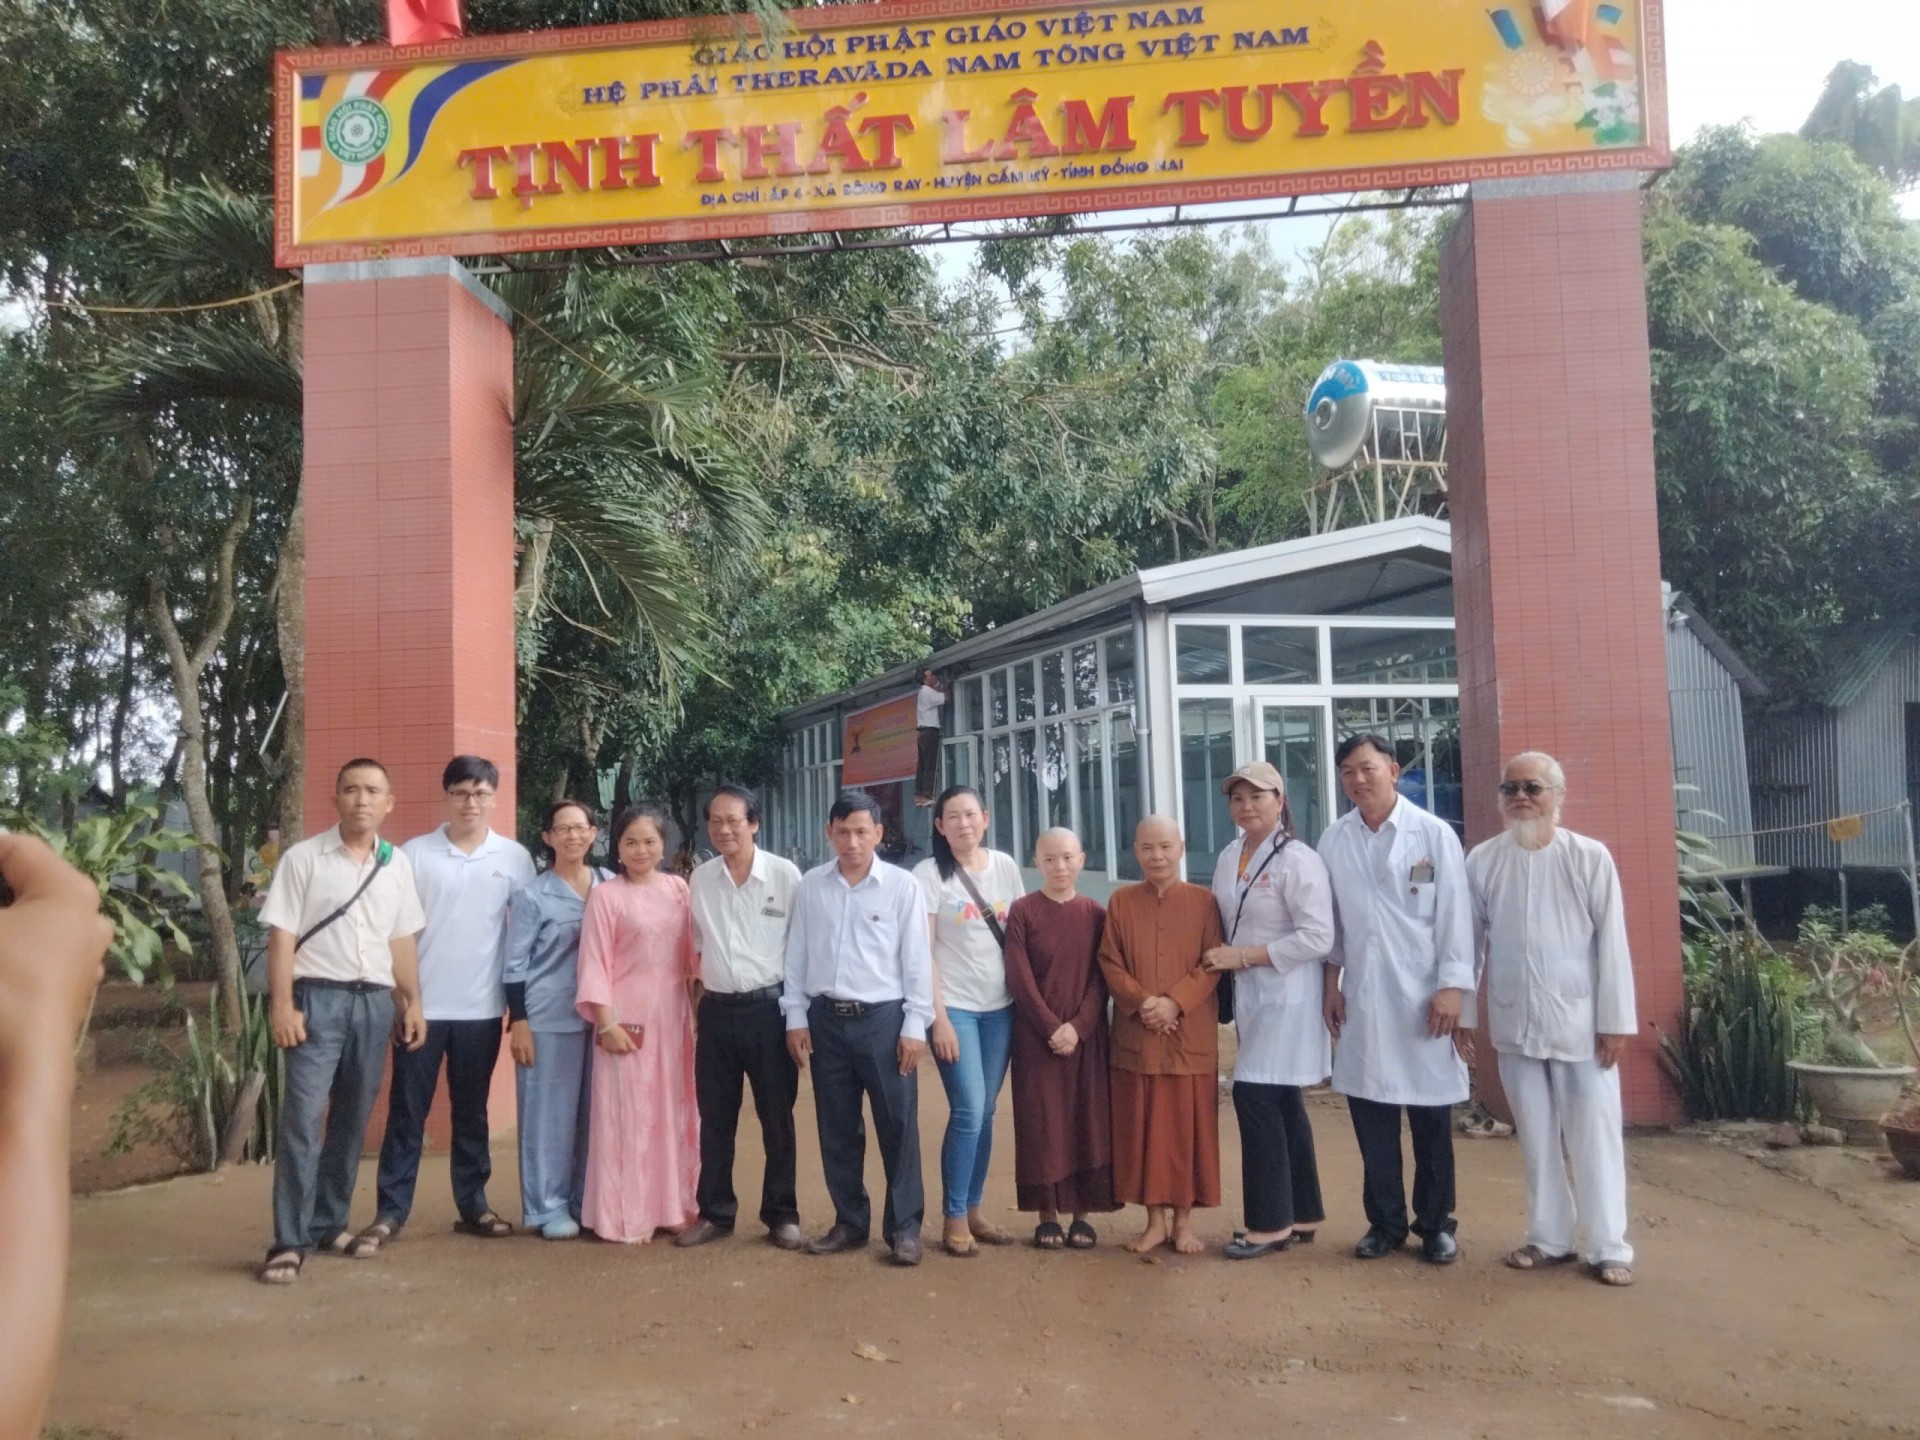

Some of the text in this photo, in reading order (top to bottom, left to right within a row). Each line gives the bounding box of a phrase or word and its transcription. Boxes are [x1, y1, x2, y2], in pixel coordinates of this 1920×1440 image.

[583, 80, 626, 105] HỆ
[947, 51, 1020, 75] NAM
[1138, 32, 1219, 59] VIỆT
[1233, 27, 1309, 49] NAM
[783, 32, 835, 60] HỘI
[846, 27, 935, 54] PHẬT
[945, 18, 1027, 44] GIÁO
[1037, 12, 1118, 38] VIỆT
[1128, 7, 1204, 29] NAM
[457, 39, 1466, 209] TỊNH THẤT LÂM TUYỀN
[701, 193, 727, 208] ĐỊA
[894, 178, 922, 192] RAY
